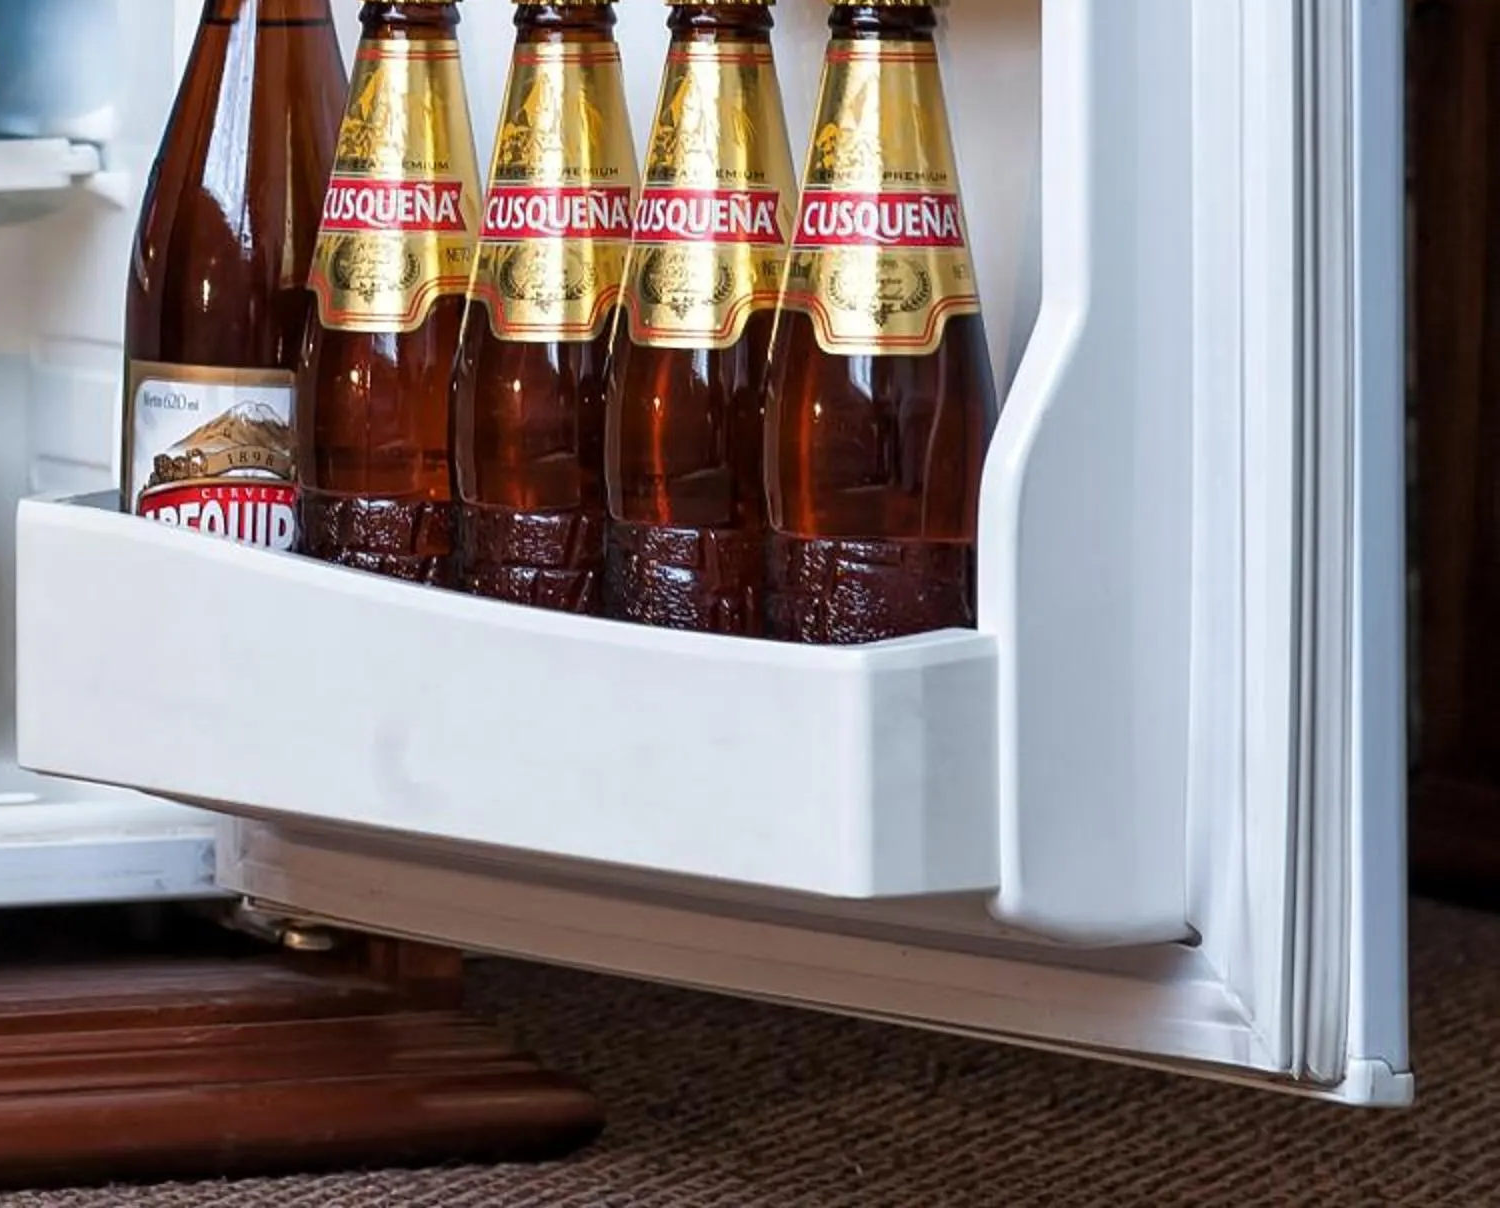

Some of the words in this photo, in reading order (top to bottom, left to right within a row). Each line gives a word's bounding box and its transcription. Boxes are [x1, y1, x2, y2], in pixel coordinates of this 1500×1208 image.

[323, 183, 458, 228] CUSQUEÑA
[485, 190, 629, 235] CUSQUEÑA
[803, 195, 958, 244] CUSQUEÑA
[163, 393, 187, 410] 620
